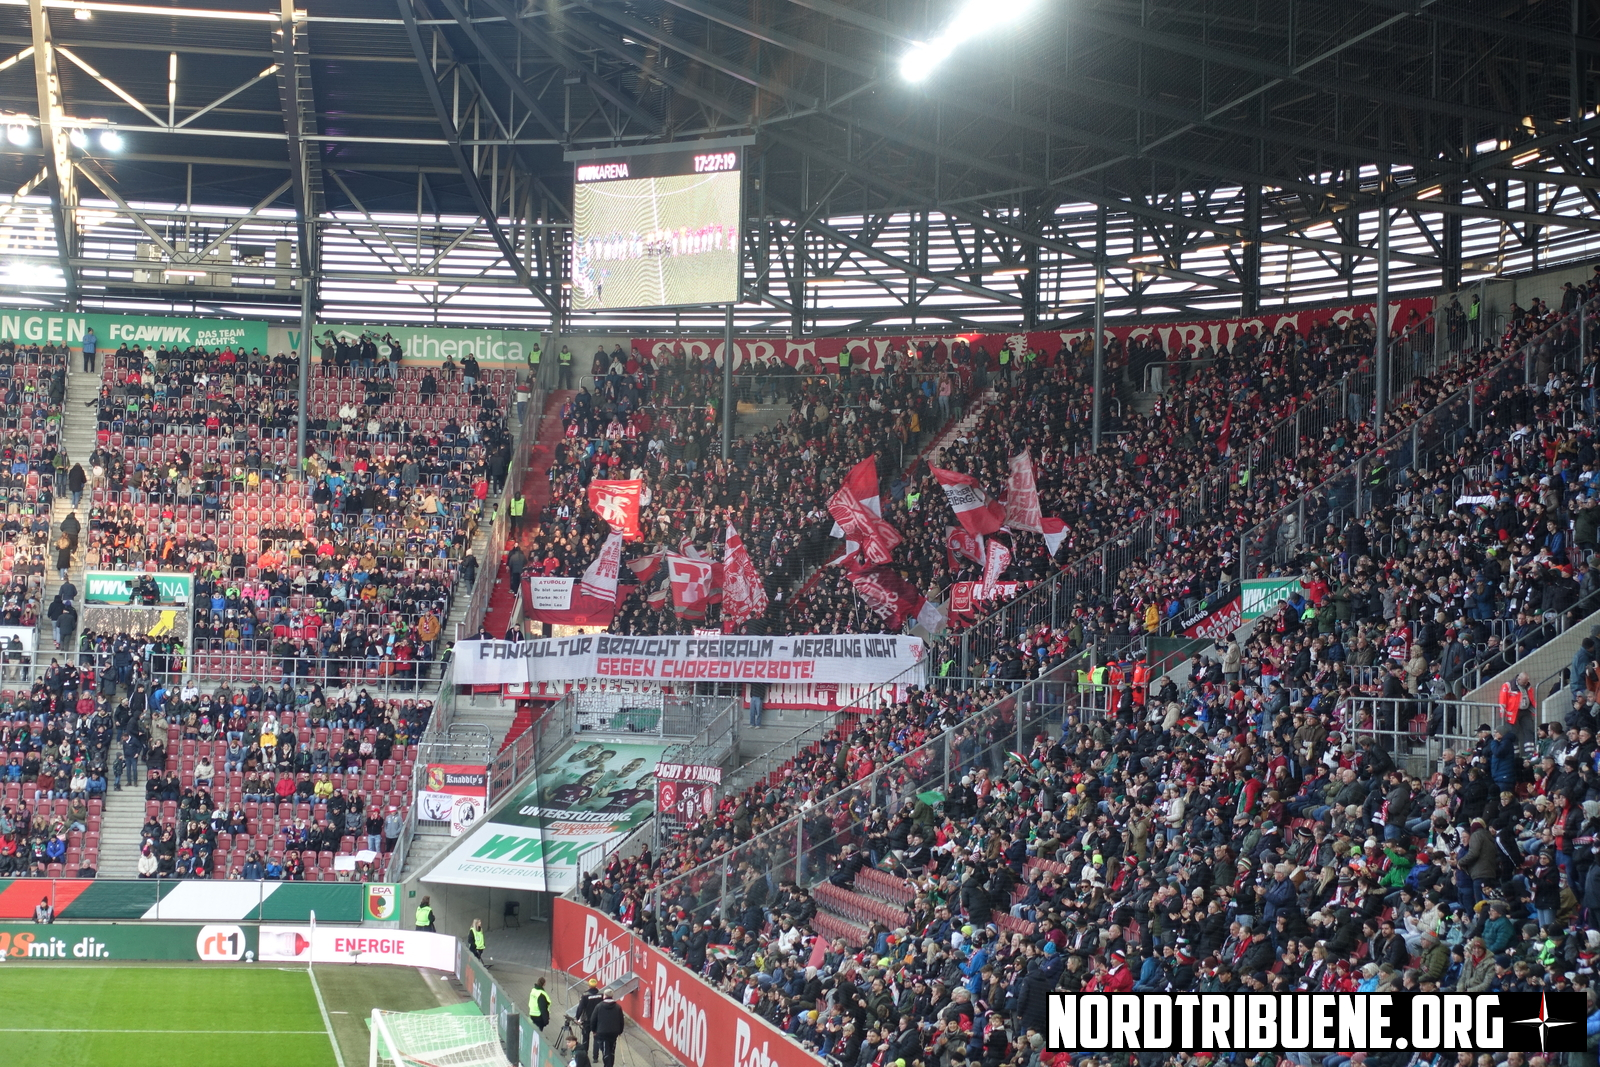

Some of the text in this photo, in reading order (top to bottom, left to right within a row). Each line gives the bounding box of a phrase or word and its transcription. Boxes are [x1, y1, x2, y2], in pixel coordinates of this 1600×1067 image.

[694, 153, 736, 172] 17:27:19
[195, 337, 239, 346] MACHT'S.
[198, 328, 245, 338] DAS TEAM
[89, 579, 185, 597] WWKENA
[1181, 610, 1209, 629] Fanclub
[479, 637, 594, 659] FANKULTUR
[597, 637, 681, 657] BRAUCHT
[685, 638, 774, 658] FREIRAUM
[792, 638, 862, 658] WERBUNG
[863, 638, 898, 658] NICHT
[597, 657, 815, 679] GEGEN CHOREOVERBOTE!
[446, 774, 483, 785] Knaddly's
[519, 805, 632, 822] UNTERSTÜTZUNG.
[471, 834, 599, 866] WWK
[458, 863, 567, 879] VERSICHERUNGEN
[28, 937, 66, 957] mit
[73, 937, 110, 957] dir.
[204, 932, 238, 955] rt1
[335, 938, 405, 955] ENERGIE
[582, 914, 628, 1001] Betano
[653, 961, 707, 1067] Betano
